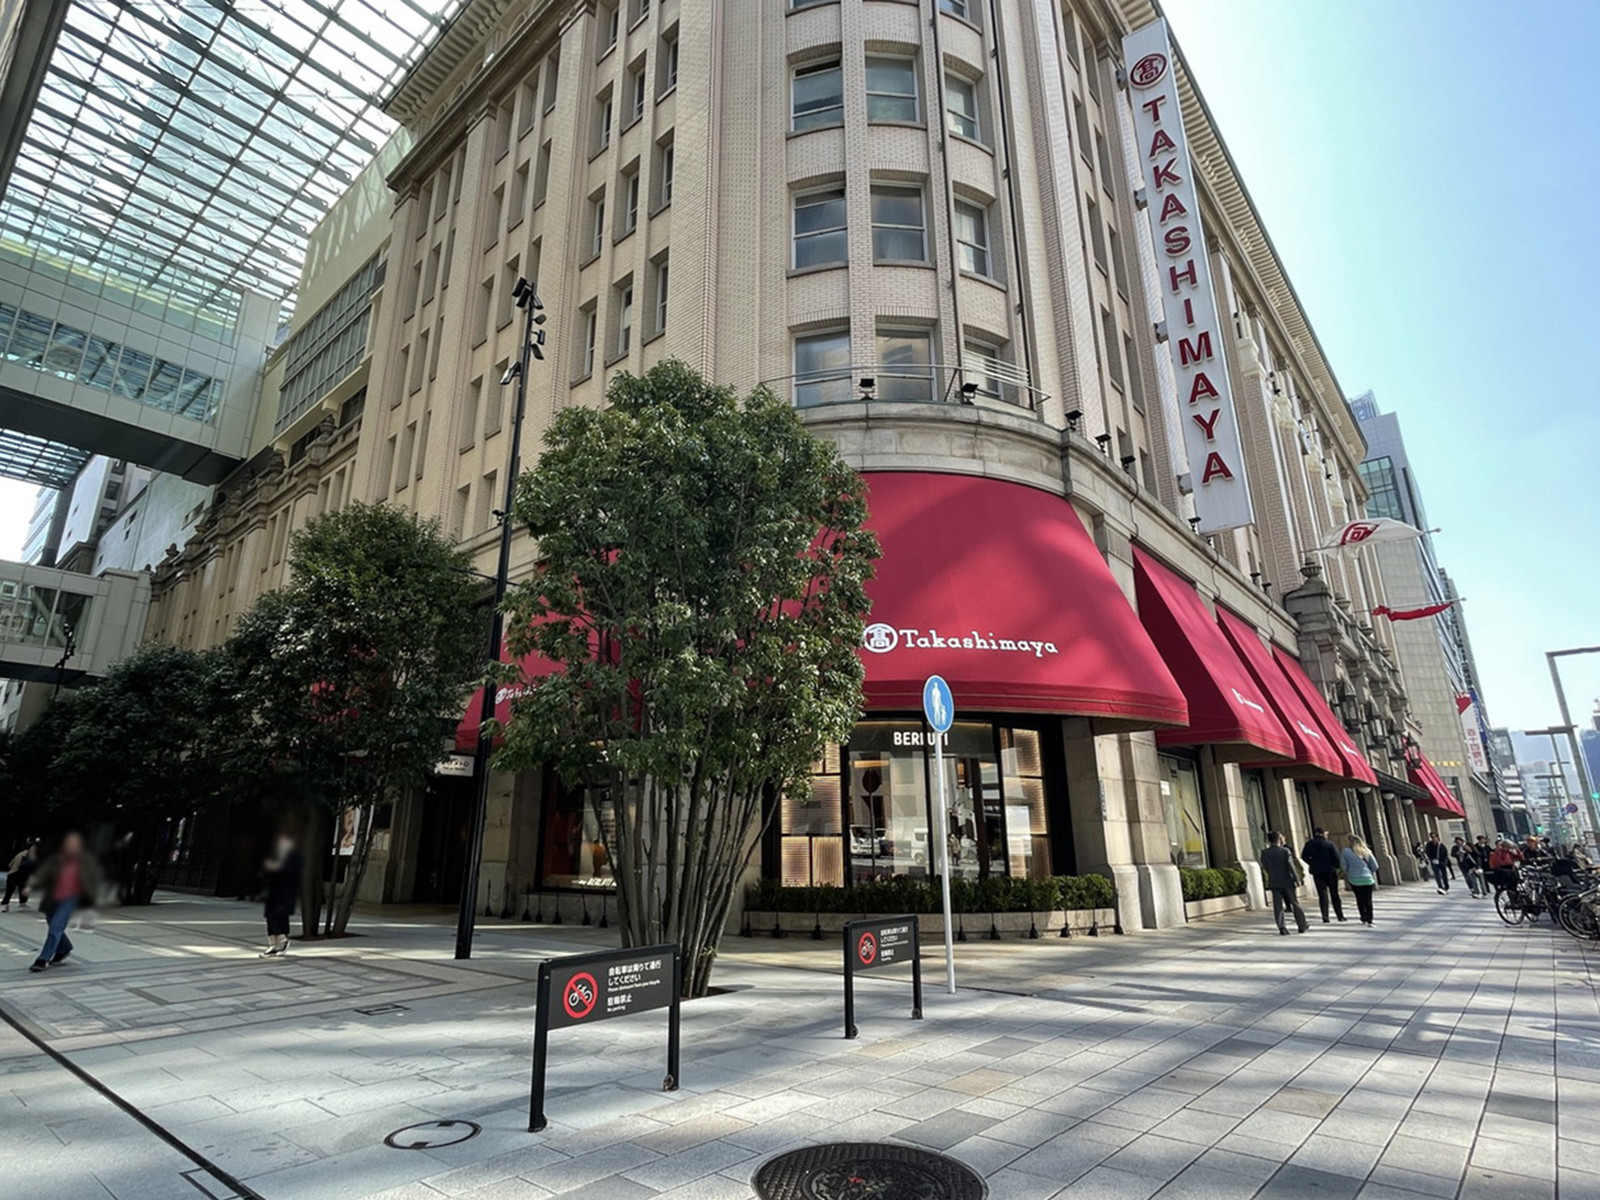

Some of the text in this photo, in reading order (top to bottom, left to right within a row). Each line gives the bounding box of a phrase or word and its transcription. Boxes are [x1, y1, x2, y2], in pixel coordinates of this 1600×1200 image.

[1143, 96, 1233, 484] TAKASHIMAYA
[899, 630, 1058, 657] Takashimaya
[893, 731, 948, 746] BERLUI
[608, 974, 641, 986] してください
